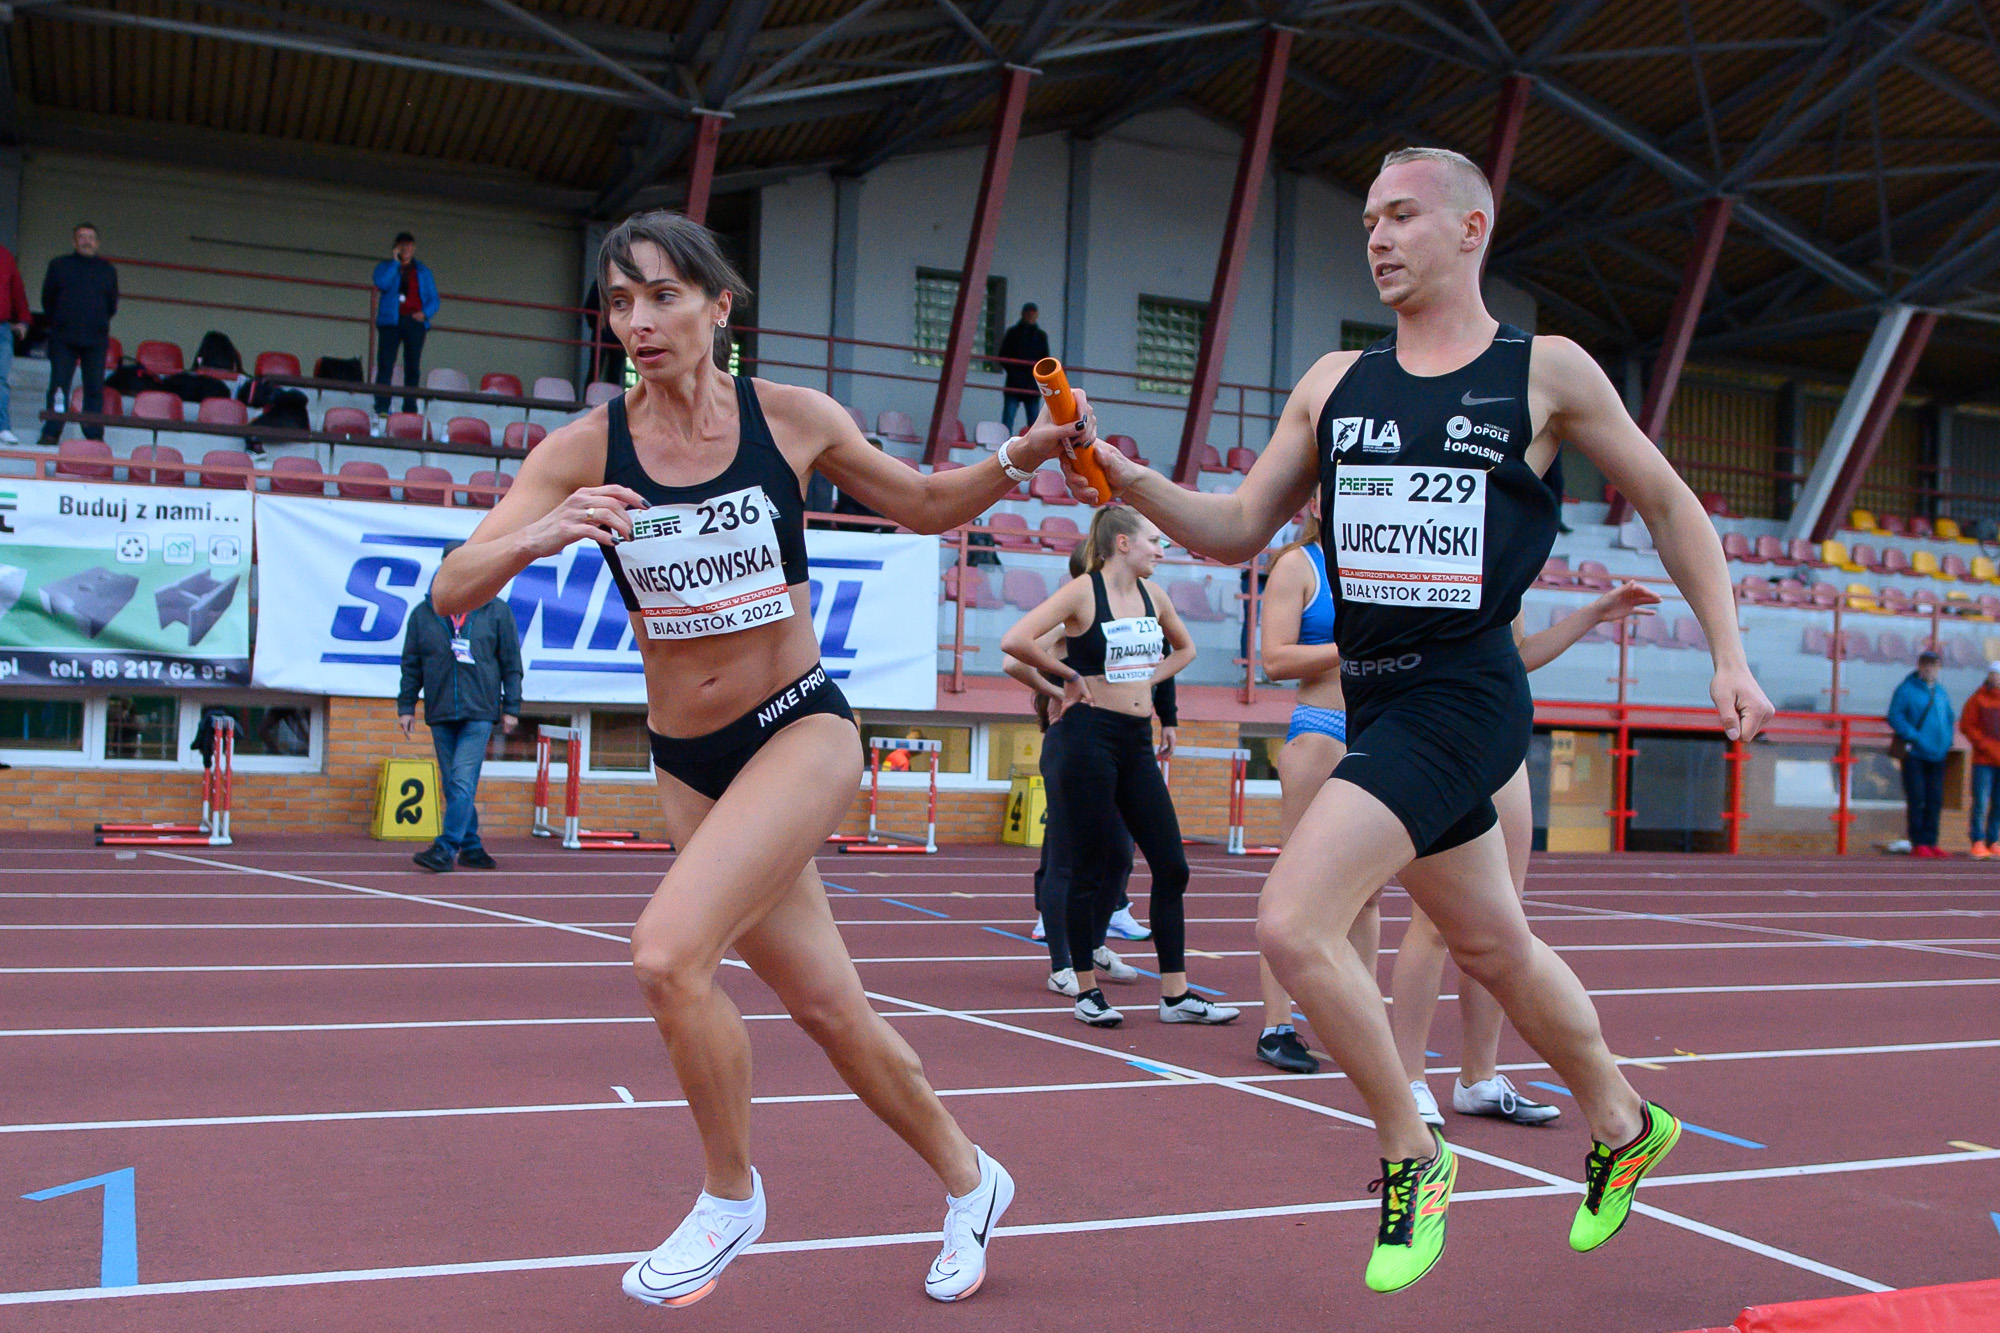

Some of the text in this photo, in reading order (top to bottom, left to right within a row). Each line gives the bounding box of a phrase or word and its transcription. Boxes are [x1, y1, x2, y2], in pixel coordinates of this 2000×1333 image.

[1363, 418, 1402, 447] LA
[1473, 425, 1510, 443] OPOLE
[1451, 441, 1505, 464] OPOLSKIE
[1407, 472, 1477, 504] 229
[59, 494, 240, 523] Buduj z nami...
[696, 494, 761, 536] 236
[618, 515, 682, 538] EFBET
[1340, 518, 1478, 557] JURCZYŃSKI
[629, 544, 776, 593] WESOŁOWSKA
[705, 601, 731, 611] POLSKI
[741, 586, 785, 603] SZTAFETACH
[1346, 583, 1472, 603] BIAŁYSTOK 2022
[652, 600, 784, 635] BIAŁYSTOK 2022
[49, 659, 85, 678] tel.
[91, 659, 118, 679] 86
[124, 660, 163, 679] 217
[168, 662, 196, 680] 62
[201, 665, 227, 680] 95
[757, 667, 826, 728] NIKE PRO
[395, 777, 425, 825] 2
